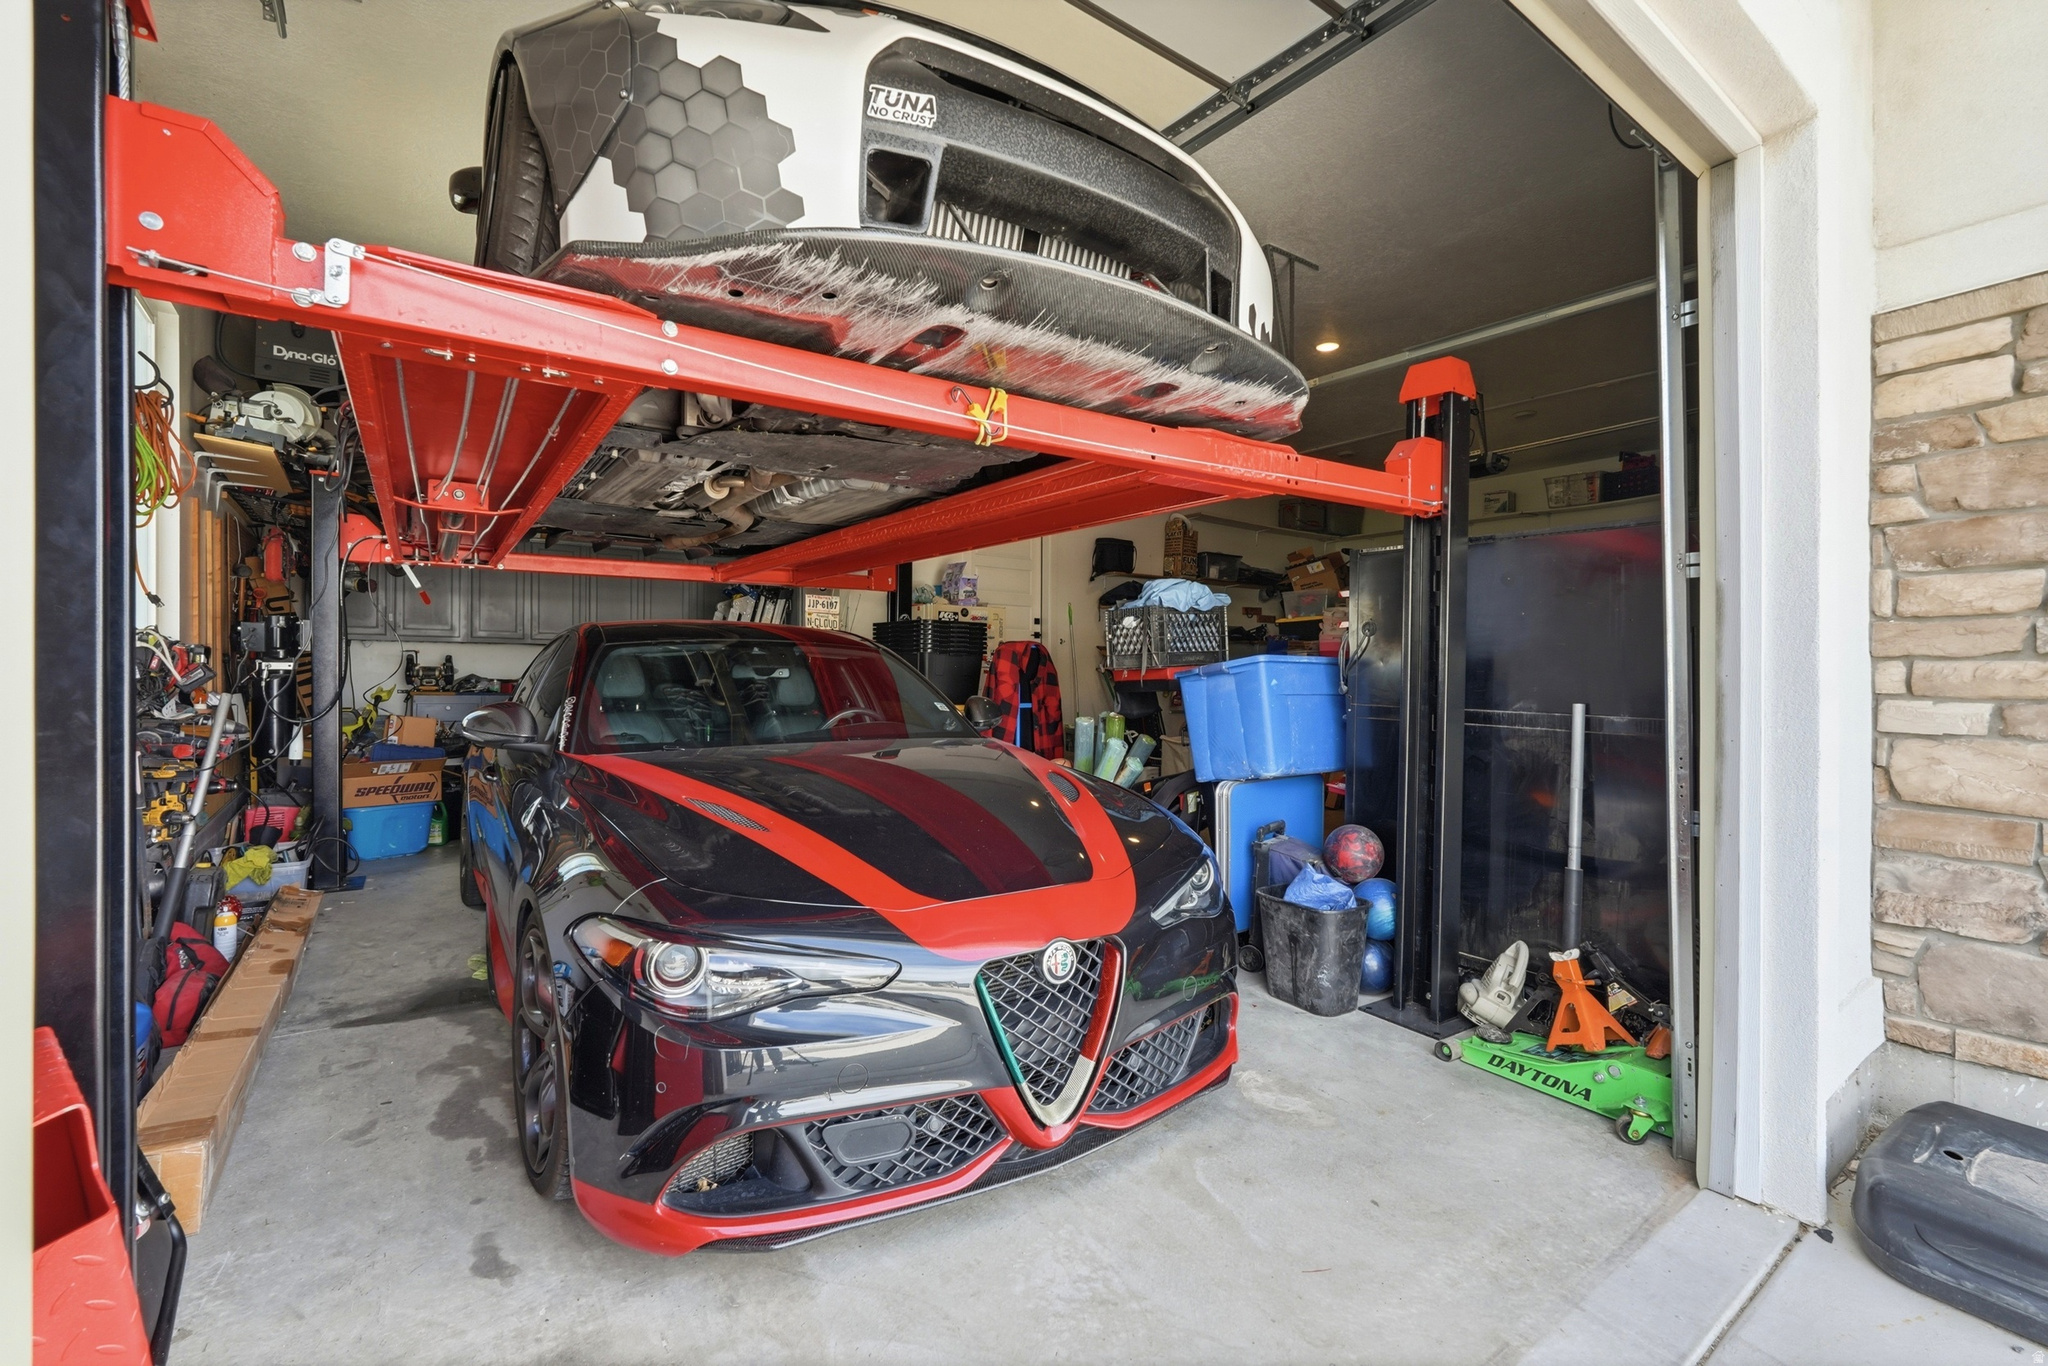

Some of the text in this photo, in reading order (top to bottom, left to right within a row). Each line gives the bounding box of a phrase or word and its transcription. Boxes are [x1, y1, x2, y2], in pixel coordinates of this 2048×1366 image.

[871, 87, 935, 115] TUNA
[869, 105, 934, 126] NO CRUST
[355, 781, 435, 797] SPEEDWAY
[1487, 1054, 1592, 1102] DAYTONA
